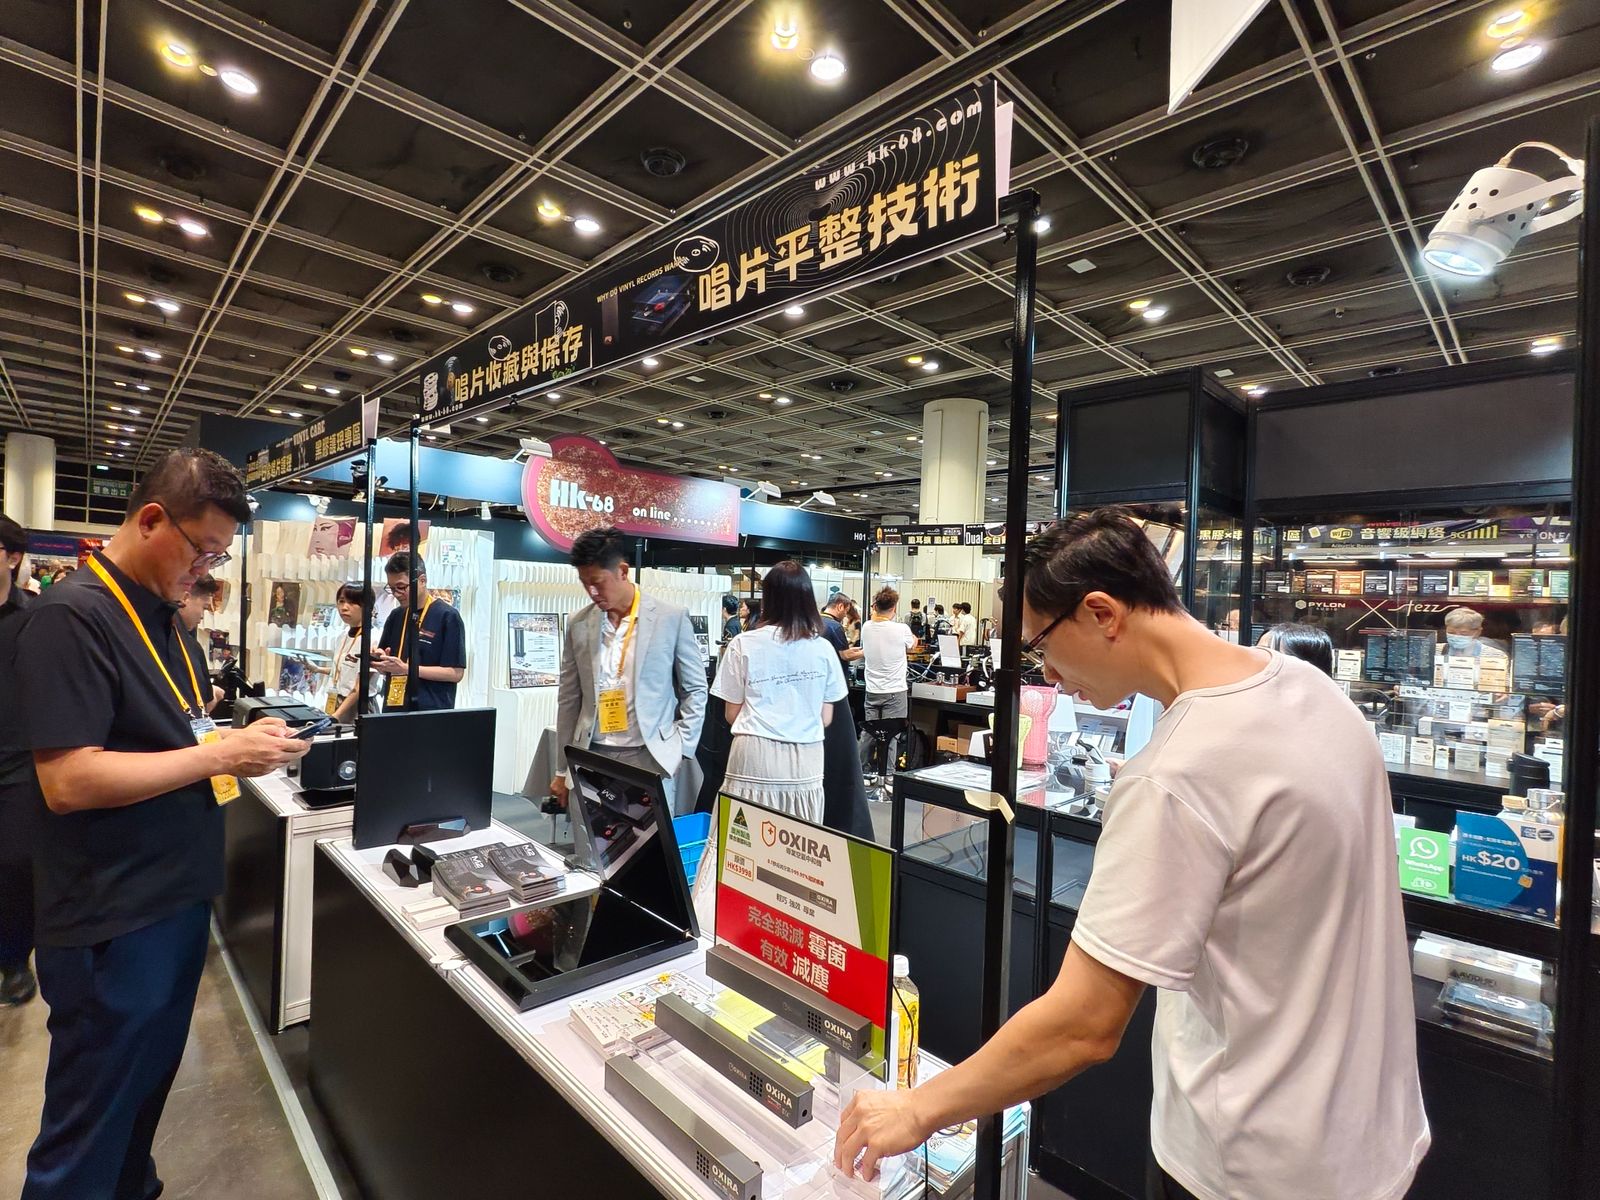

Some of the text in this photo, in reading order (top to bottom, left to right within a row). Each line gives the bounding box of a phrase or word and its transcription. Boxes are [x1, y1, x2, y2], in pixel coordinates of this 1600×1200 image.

[815, 101, 982, 191] www.hk-68.com
[699, 153, 980, 312] 唱片平整技術
[597, 292, 609, 303] WHY
[610, 287, 618, 297] DO
[619, 280, 636, 293] VINYL
[637, 266, 664, 284] RECORDS
[454, 324, 583, 402] 唱片收藏與保存
[550, 479, 615, 513] Hk-68
[632, 506, 671, 521] on line
[854, 532, 866, 541] H01
[966, 532, 983, 545] Dual
[1360, 526, 1445, 540] 音響級網絡
[779, 829, 831, 862] OXIRA
[1462, 851, 1520, 871] HK$20
[727, 861, 752, 878] HK$3998
[760, 939, 829, 993] 有效 減塵
[808, 931, 847, 972] 霉菌
[824, 1020, 853, 1042] OXIRA
[765, 1082, 792, 1109] OXIRA
[711, 1164, 739, 1196] OXIRA
